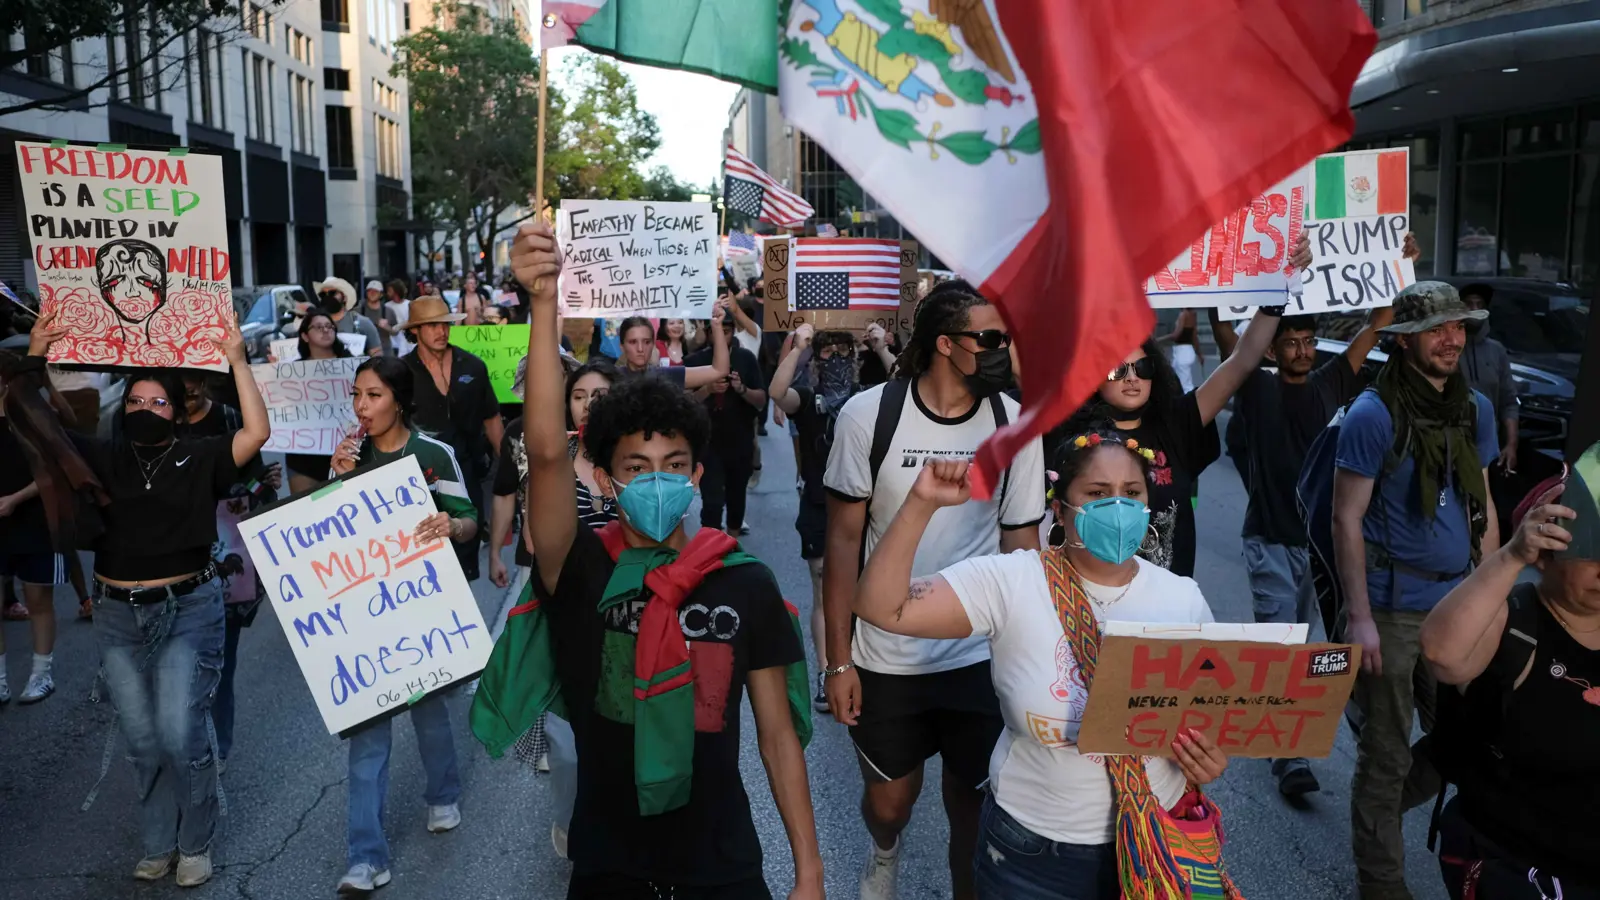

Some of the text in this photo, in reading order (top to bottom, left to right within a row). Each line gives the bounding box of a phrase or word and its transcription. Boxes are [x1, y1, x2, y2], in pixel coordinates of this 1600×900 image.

[20, 145, 188, 186] FREEDOM
[77, 183, 95, 207] A
[103, 187, 201, 217] SEED
[31, 214, 139, 240] PLANTED
[570, 205, 704, 240] EMPATHY BECAME
[167, 245, 230, 282] NEED
[564, 237, 710, 264] RADICAL WHEN THOSE AT
[574, 263, 700, 285] THE TOP LOST ALL
[591, 286, 682, 309] HUMANITY
[465, 326, 503, 343] ONLY
[272, 361, 306, 379] YOU
[279, 573, 304, 603] a
[368, 560, 443, 617] dad
[330, 608, 478, 706] doesnt
[1130, 644, 1328, 700] HATE
[1312, 661, 1348, 674] TRUMP
[376, 667, 453, 708] 06-14-25
[1128, 695, 1298, 709] NEVER MADE AMERICA
[1126, 709, 1326, 750] GREAT
